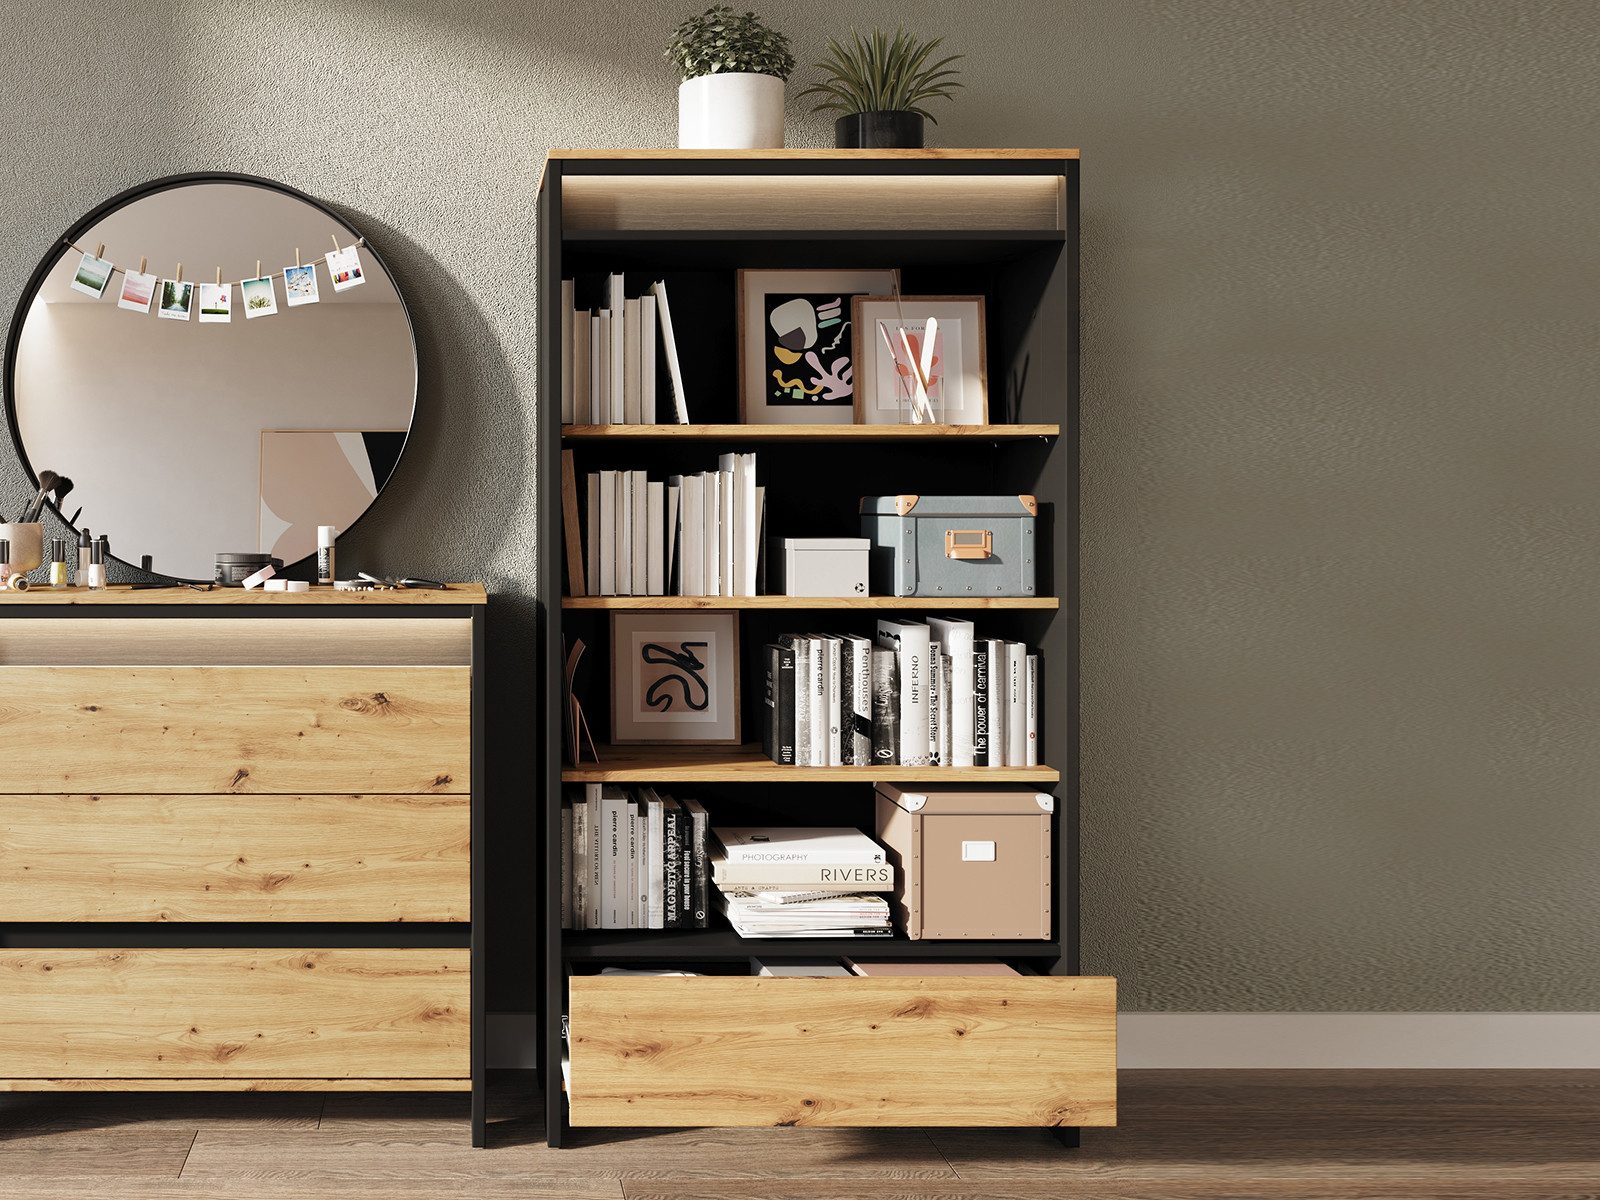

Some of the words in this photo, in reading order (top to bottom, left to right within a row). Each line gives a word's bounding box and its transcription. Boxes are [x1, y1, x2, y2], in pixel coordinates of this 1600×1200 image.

[930, 645, 938, 665] Donna
[861, 646, 871, 713] Penthouses
[930, 665, 938, 691] Summer
[973, 651, 987, 690] carnival
[930, 694, 938, 706] The
[973, 690, 987, 704] of
[930, 707, 938, 726] Secret
[974, 705, 989, 736] power
[929, 726, 938, 743] Story
[973, 737, 987, 756] The
[742, 853, 808, 862] PHOTOGRAPHY
[821, 868, 889, 882] RIVERS
[667, 860, 676, 922] MAGNETIC
